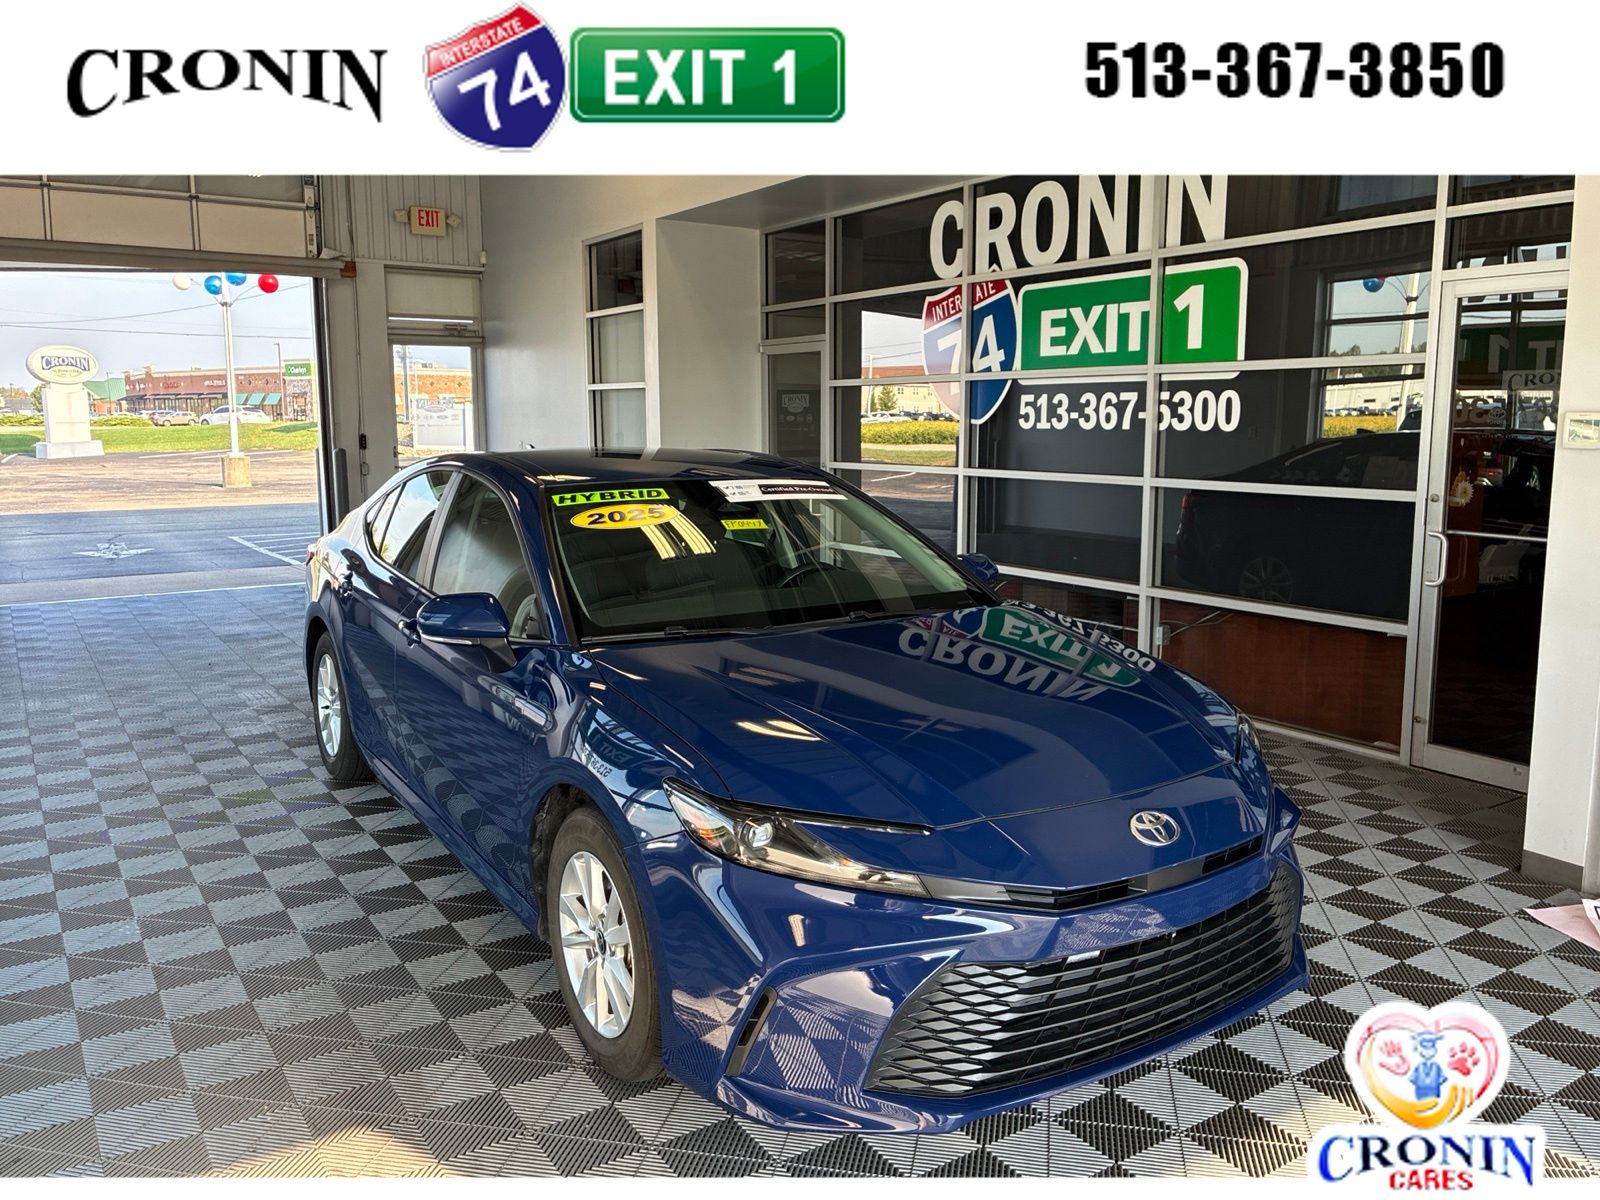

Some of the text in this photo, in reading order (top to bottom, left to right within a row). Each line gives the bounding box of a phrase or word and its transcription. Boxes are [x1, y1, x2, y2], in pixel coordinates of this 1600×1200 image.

[418, 209, 440, 228] EXIT
[930, 175, 1228, 280] CRONIN
[931, 281, 997, 322] INTERATE
[1040, 284, 1204, 357] EXIT 1
[41, 356, 90, 371] CRONIN
[937, 314, 1006, 395] 74
[1018, 390, 1241, 432] 513-367-5300
[558, 489, 662, 504] HYBRID
[587, 507, 665, 525] 2025
